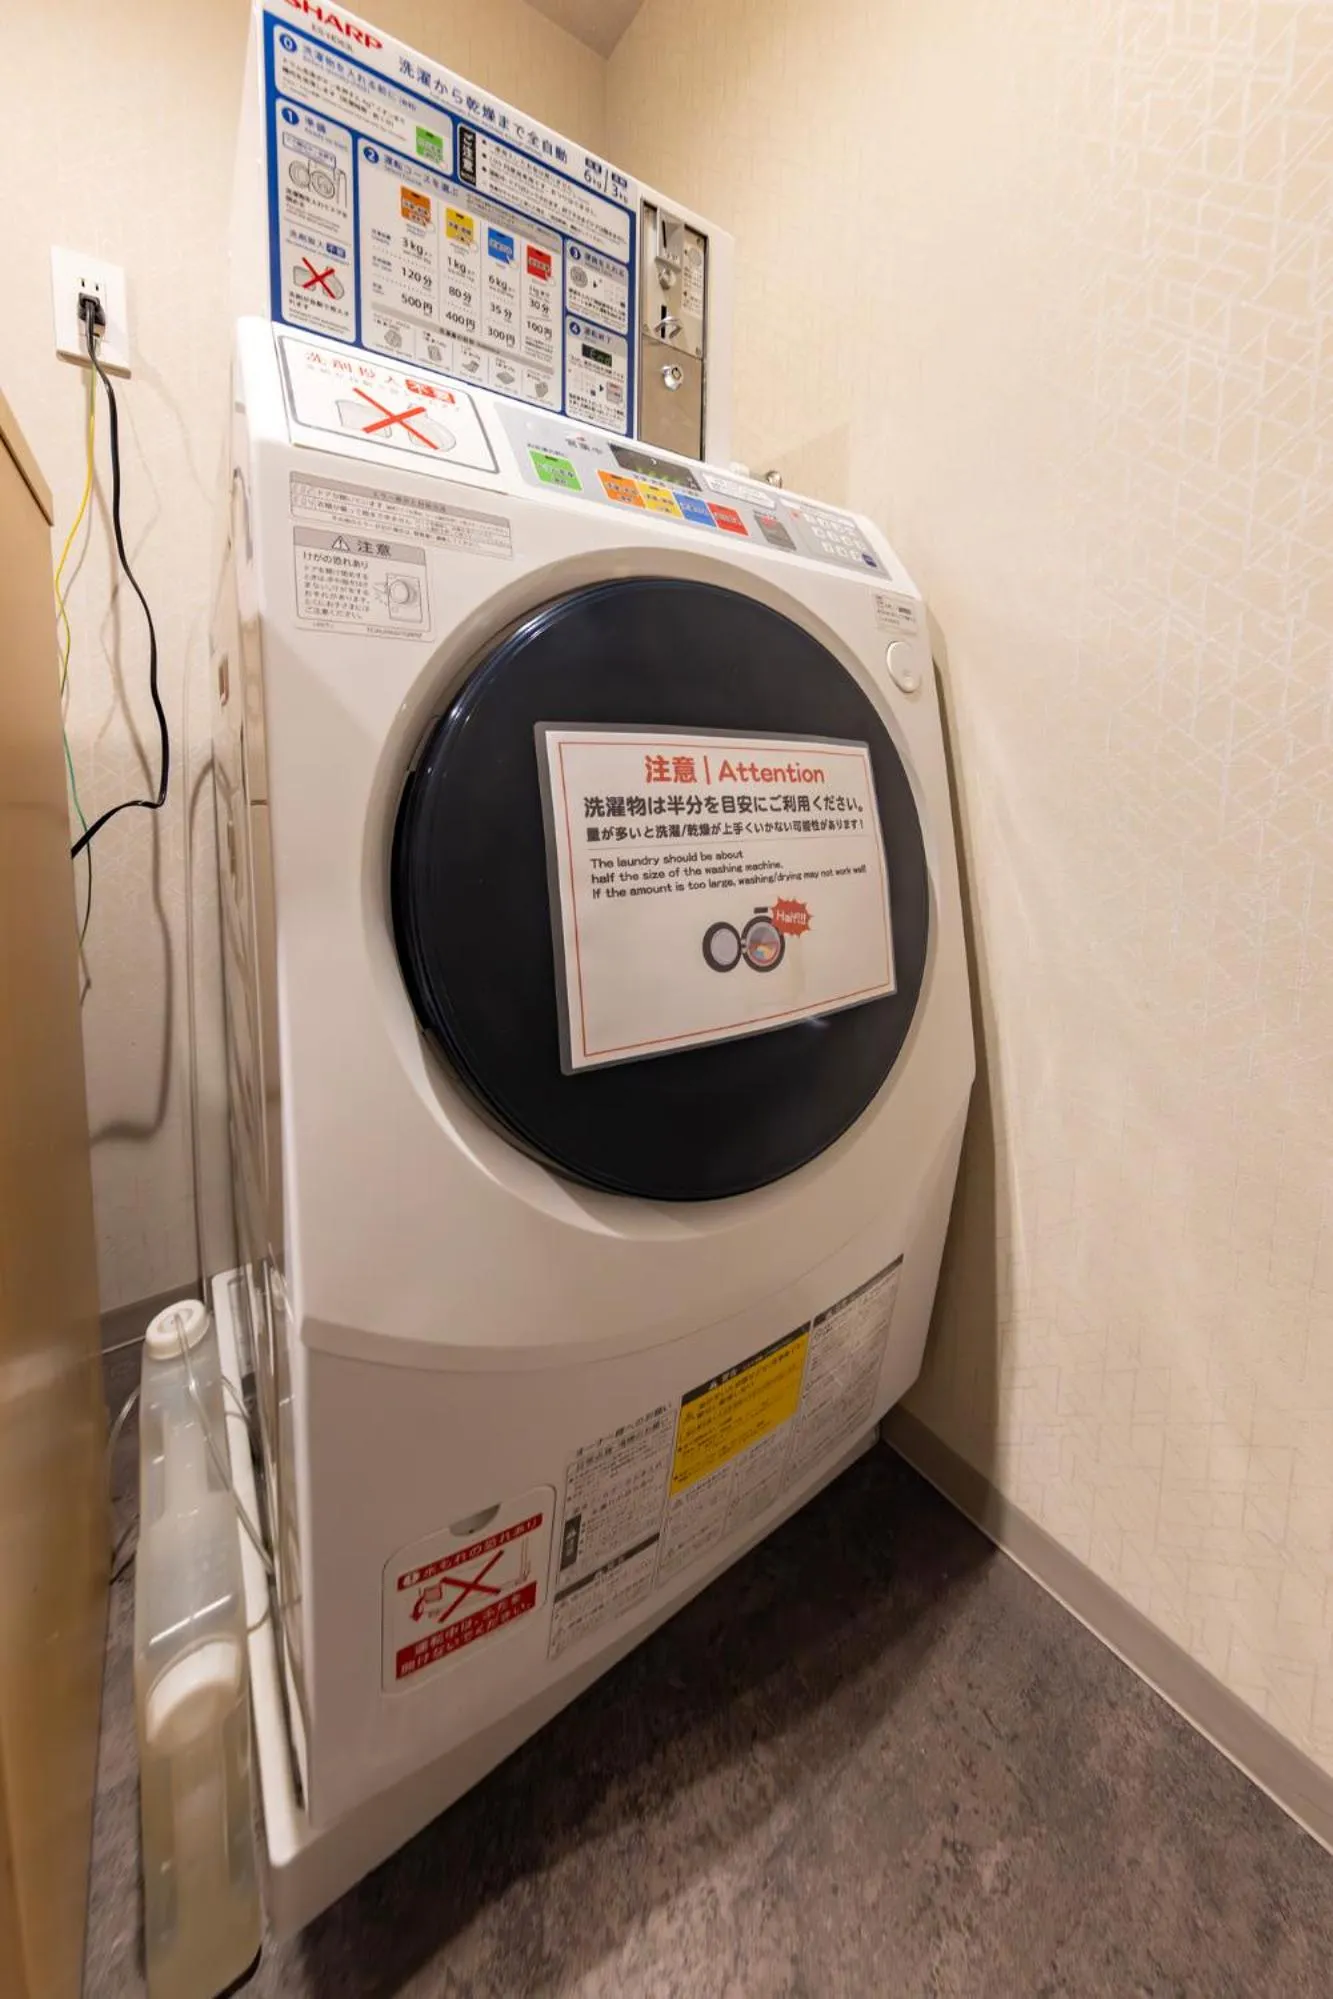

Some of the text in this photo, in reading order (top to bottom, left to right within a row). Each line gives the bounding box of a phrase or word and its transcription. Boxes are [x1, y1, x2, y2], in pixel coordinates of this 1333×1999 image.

[397, 55, 568, 165] 洗濯から乾燥まで全自動
[401, 265, 432, 289] 120分
[401, 292, 432, 315] 500円
[448, 284, 471, 304] 80分
[445, 309, 475, 331] 400円
[487, 325, 515, 346] 300円
[357, 541, 391, 557] 注意
[644, 754, 826, 783] 注意 Attention
[583, 794, 864, 818] 洗濯物は半分を目安にご利用ください。
[591, 850, 743, 869] The laundry should be about
[591, 859, 783, 884] half the size of the washing machine.
[592, 887, 601, 899] If
[605, 887, 627, 898] the
[629, 883, 673, 896] amount
[675, 882, 686, 891] is
[688, 880, 706, 890] too
[803, 871, 819, 880] may
[820, 869, 833, 877] not
[835, 867, 851, 876] work
